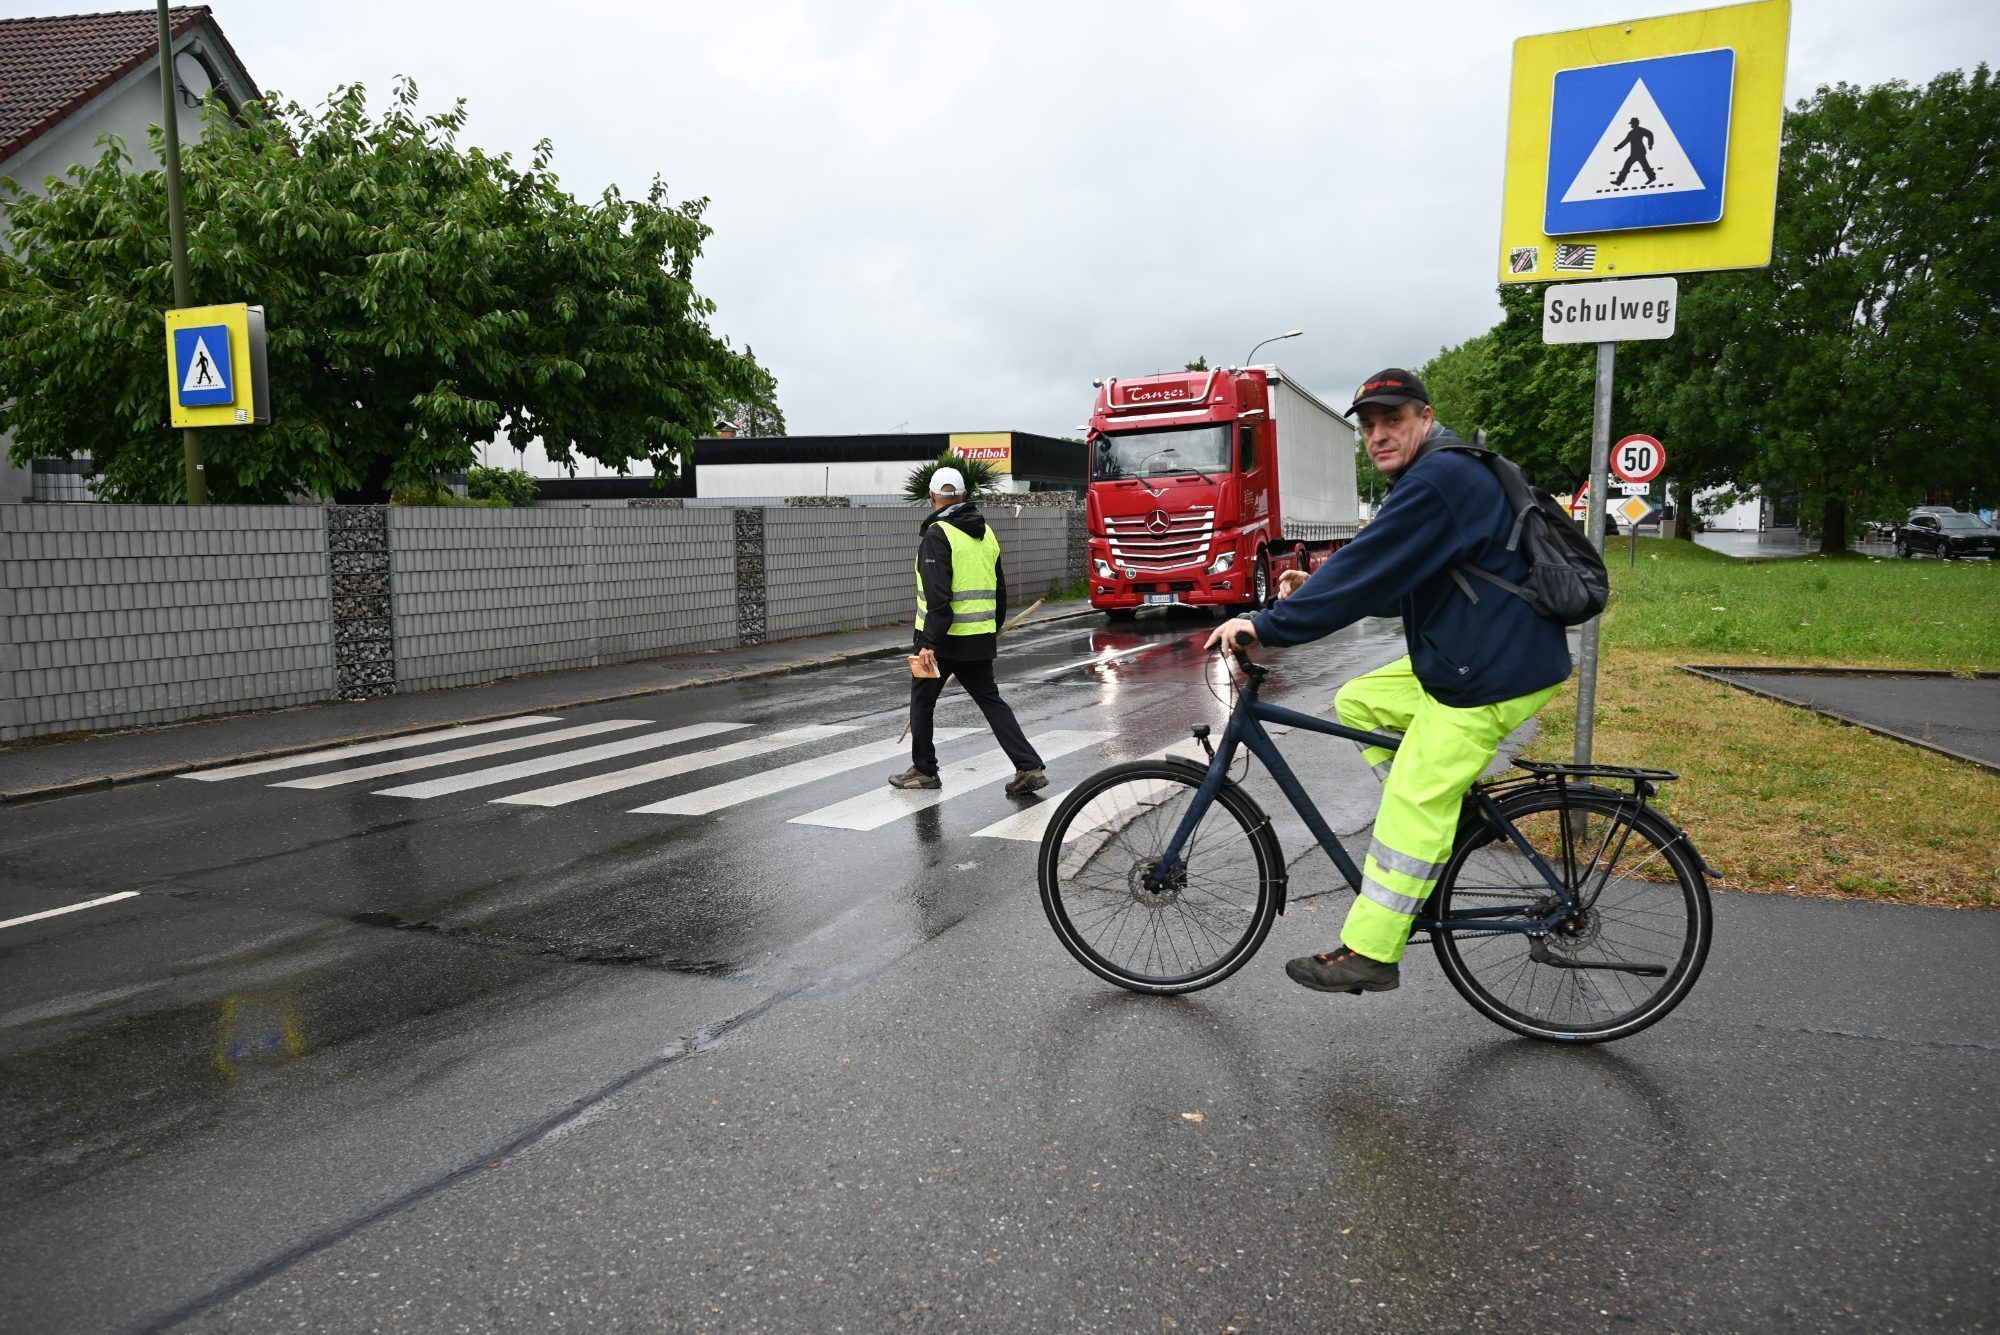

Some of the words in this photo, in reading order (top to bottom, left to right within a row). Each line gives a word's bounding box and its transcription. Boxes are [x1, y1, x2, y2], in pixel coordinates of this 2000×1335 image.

[1550, 296, 1669, 324] Schulweg
[1127, 386, 1185, 401] Tanzer
[968, 447, 1006, 459] Helbok
[1624, 447, 1651, 471] 50
